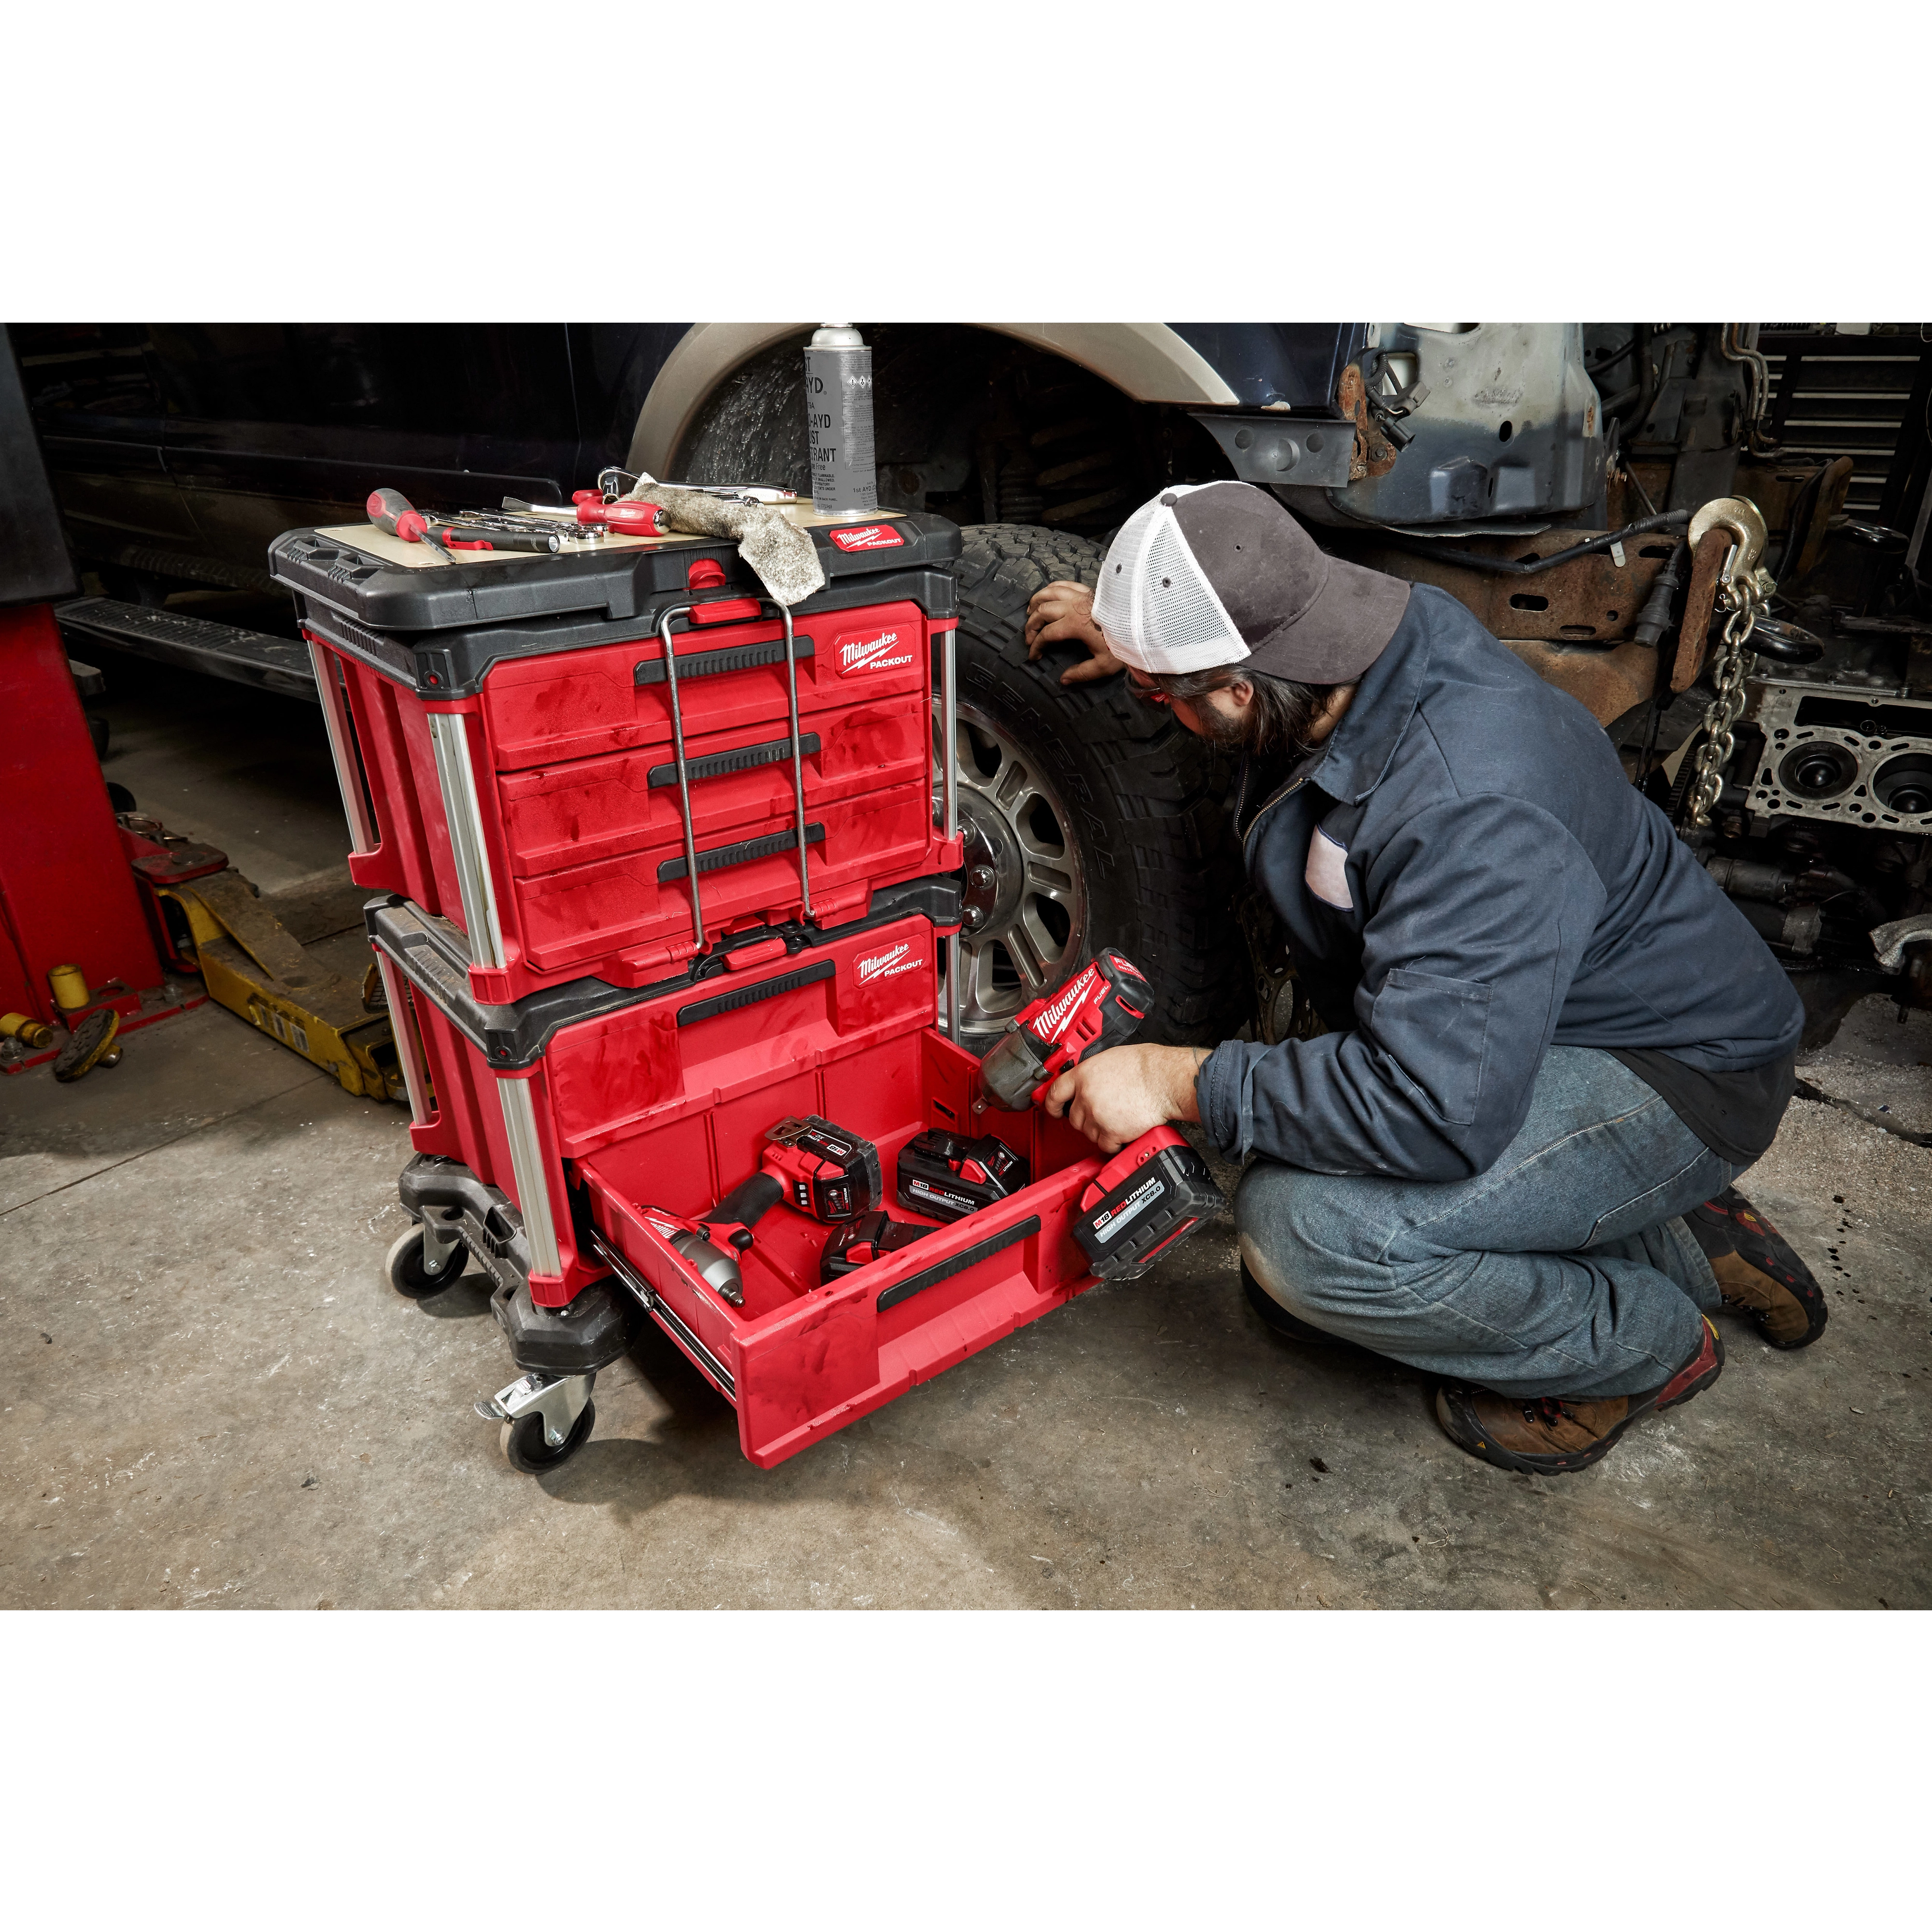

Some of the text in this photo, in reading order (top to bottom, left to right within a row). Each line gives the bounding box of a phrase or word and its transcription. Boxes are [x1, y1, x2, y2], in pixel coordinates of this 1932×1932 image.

[837, 528, 881, 545] Milwaukee
[867, 538, 901, 546] PACKOUT
[839, 632, 897, 666] Milwaukee
[870, 654, 913, 669] PACKOUT
[966, 661, 1116, 880] GENERAL
[857, 943, 909, 979] Milwaukee
[884, 959, 923, 977] PACKOUT
[1033, 967, 1095, 1039] Milwaukee
[1094, 985, 1109, 1005] FUEL
[829, 1146, 845, 1154] M18
[913, 1180, 975, 1205] M18 REDLITHIUM
[913, 1189, 975, 1212] HIGH OUTPUT XC8.0
[1094, 1177, 1156, 1228] M18 REDLITHIUM
[1100, 1186, 1161, 1237] HIGH OUTPUT XC8.0
